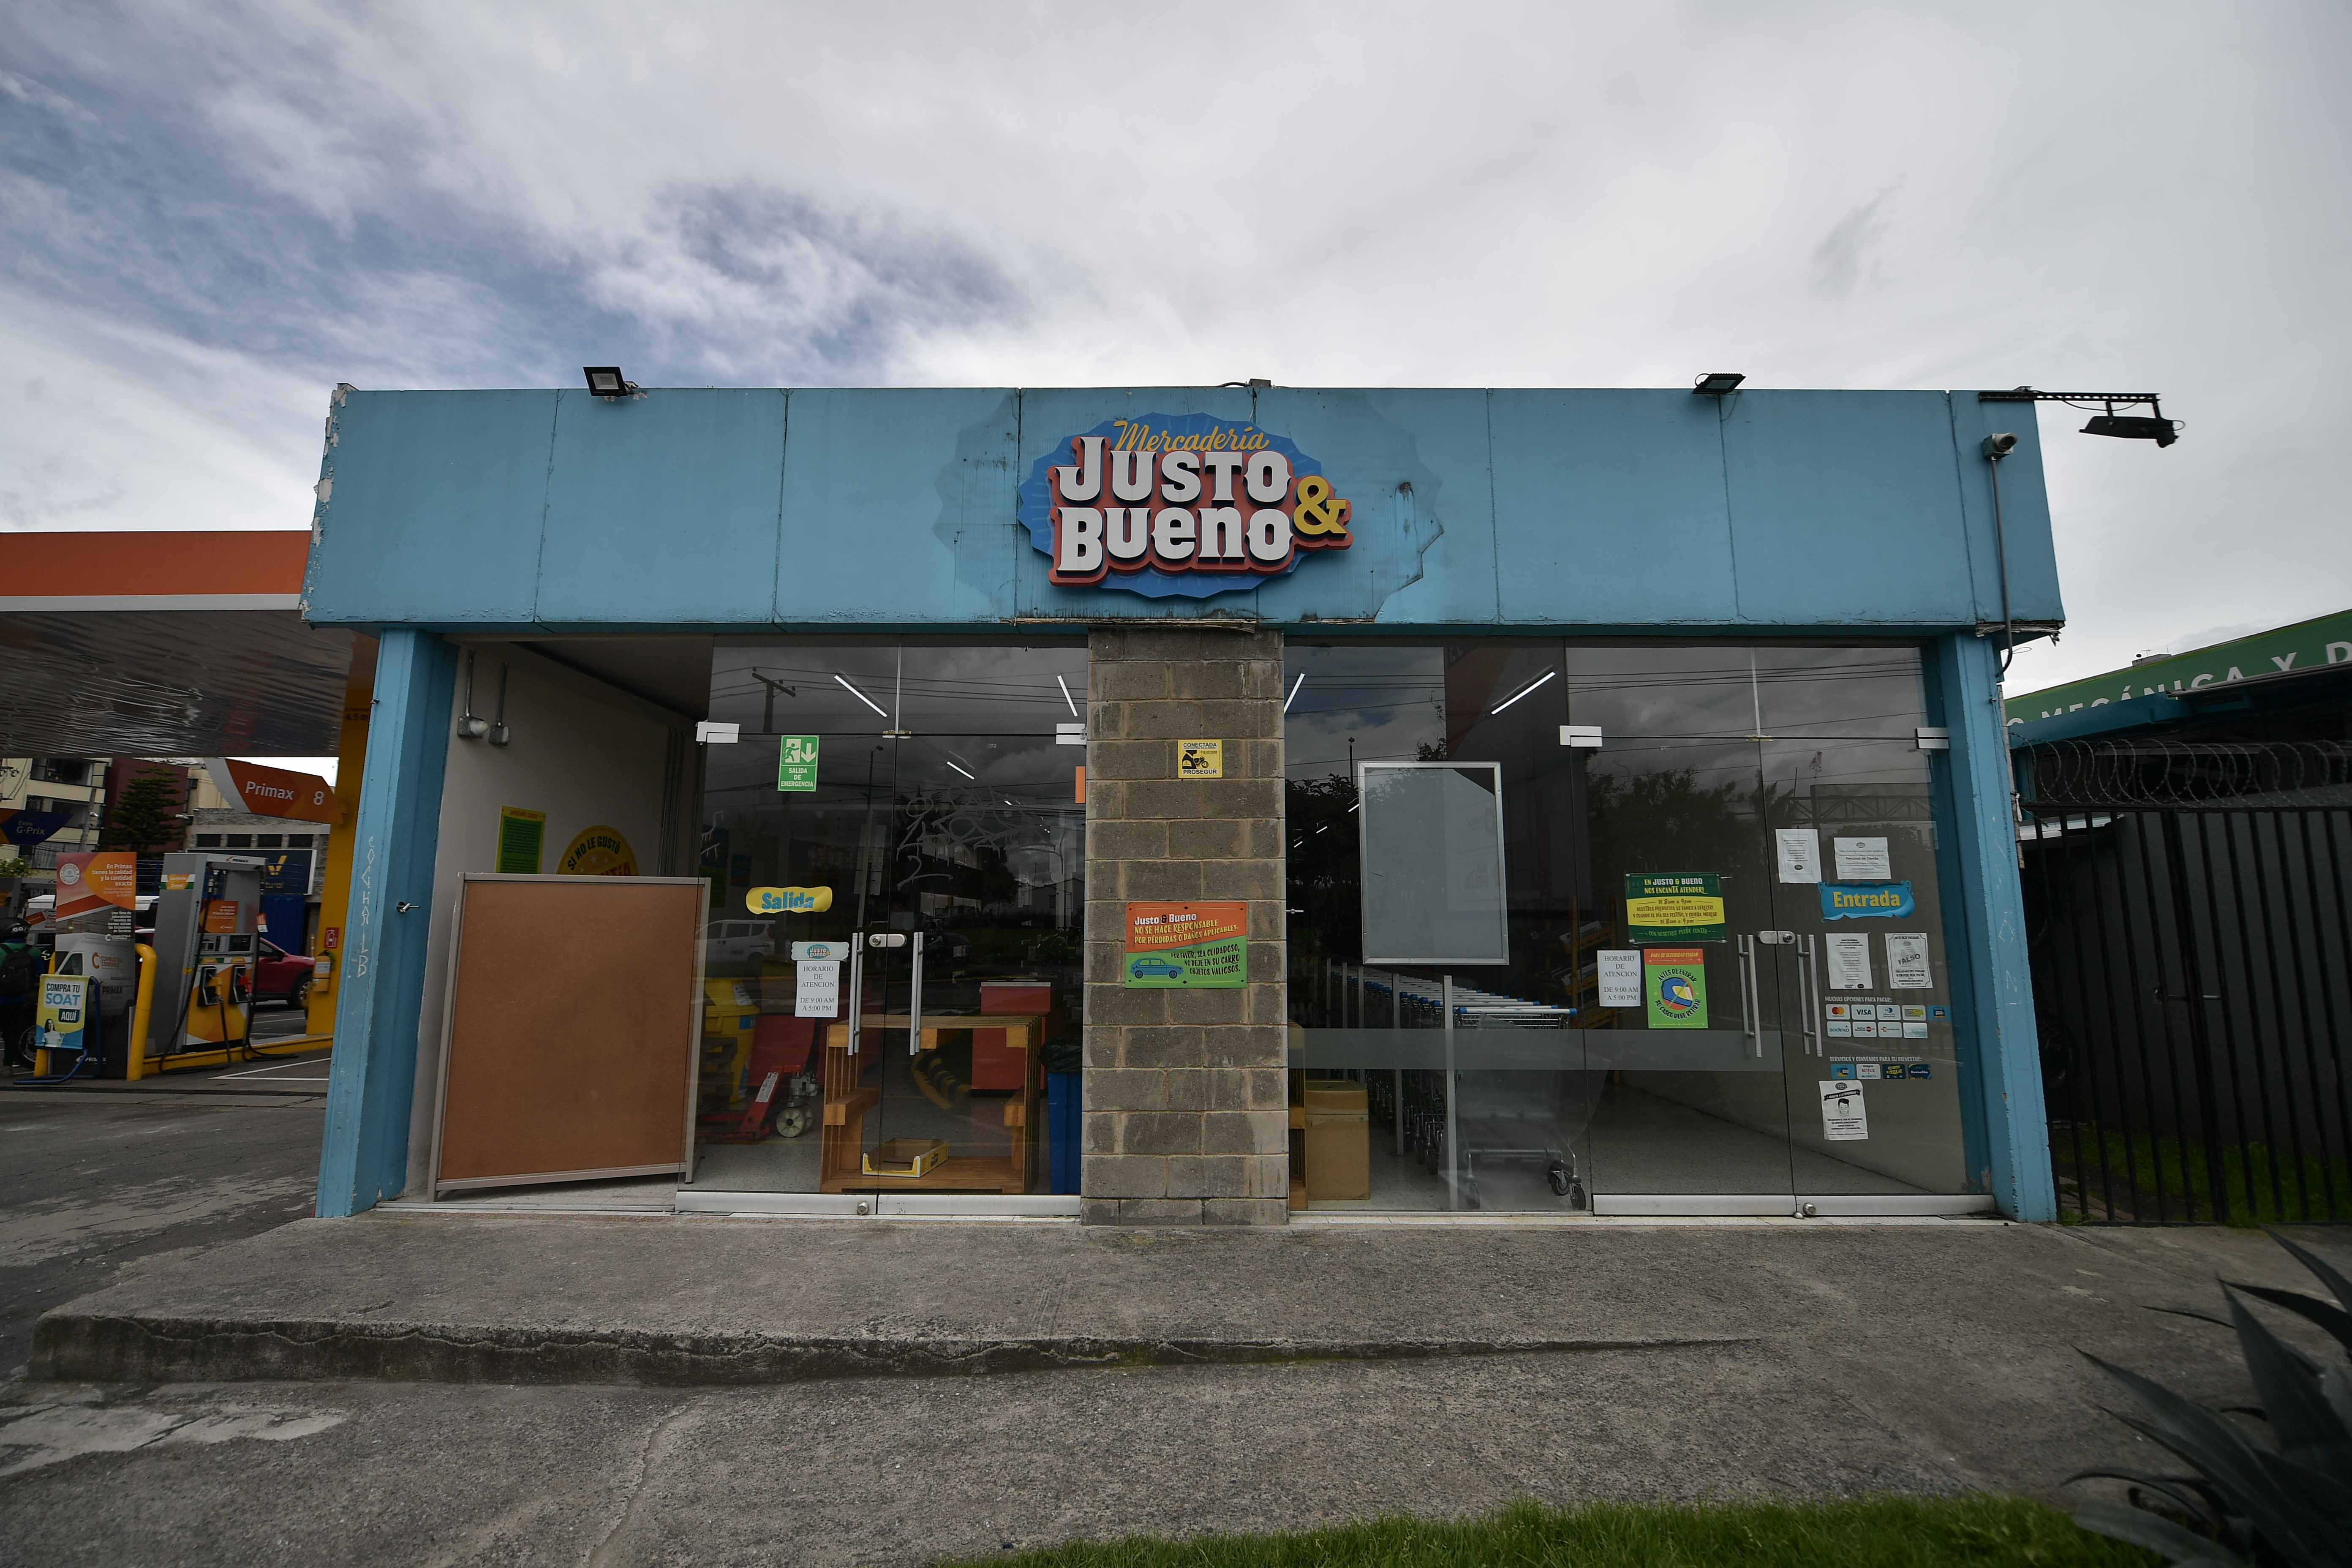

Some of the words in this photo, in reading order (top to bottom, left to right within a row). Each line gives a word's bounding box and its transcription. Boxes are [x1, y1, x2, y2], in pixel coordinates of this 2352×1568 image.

[1113, 421, 1269, 452] Mercadería
[1054, 436, 1291, 504] JUSTO
[1293, 476, 1348, 536] &
[2270, 652, 2297, 671] Y
[245, 781, 294, 800] Primax
[313, 791, 324, 805] 8
[17, 826, 45, 835] G-Prix
[567, 856, 577, 870] SI
[574, 843, 586, 860] NO
[587, 837, 595, 849] LE
[597, 836, 621, 854] GUSTÓ
[1656, 886, 1679, 894] ENCANTA
[1680, 886, 1708, 895] ATENDER!
[762, 891, 815, 909] Salida
[1833, 890, 1900, 907] Entrada
[1134, 916, 1159, 925] Justo
[1161, 915, 1167, 924] &
[1169, 914, 1197, 923] Bueno
[1134, 926, 1143, 935] NO
[1144, 926, 1152, 934] SE
[1154, 925, 1171, 934] HACE
[1173, 919, 1218, 934] RESPONSABLE
[1134, 936, 1146, 945] POR
[1147, 934, 1177, 945] PÉRDIDAS
[1184, 931, 1202, 941] DAÑOS
[1203, 924, 1239, 937] APLICABLES.
[1180, 950, 1196, 959] FAVOR,
[1207, 943, 1240, 956] CUIDADOSO,
[1212, 958, 1220, 966] SU
[1221, 954, 1240, 965] CARRO
[1898, 953, 1920, 965] FALSO
[1189, 968, 1210, 976] OBJETOS
[1211, 964, 1241, 976] VALIOSOS.
[1657, 969, 1671, 982] ANTES
[1679, 969, 1697, 983] ENTRAR
[47, 983, 71, 992] COMPRA
[73, 985, 80, 993] TU
[103, 986, 122, 994] PRIMAX
[46, 993, 81, 1005] SOAT
[61, 1010, 77, 1021] AQUÍ
[1655, 1000, 1662, 1008] SU
[1659, 1007, 1673, 1018] CASCO
[1686, 999, 1701, 1018] RETIRAR
